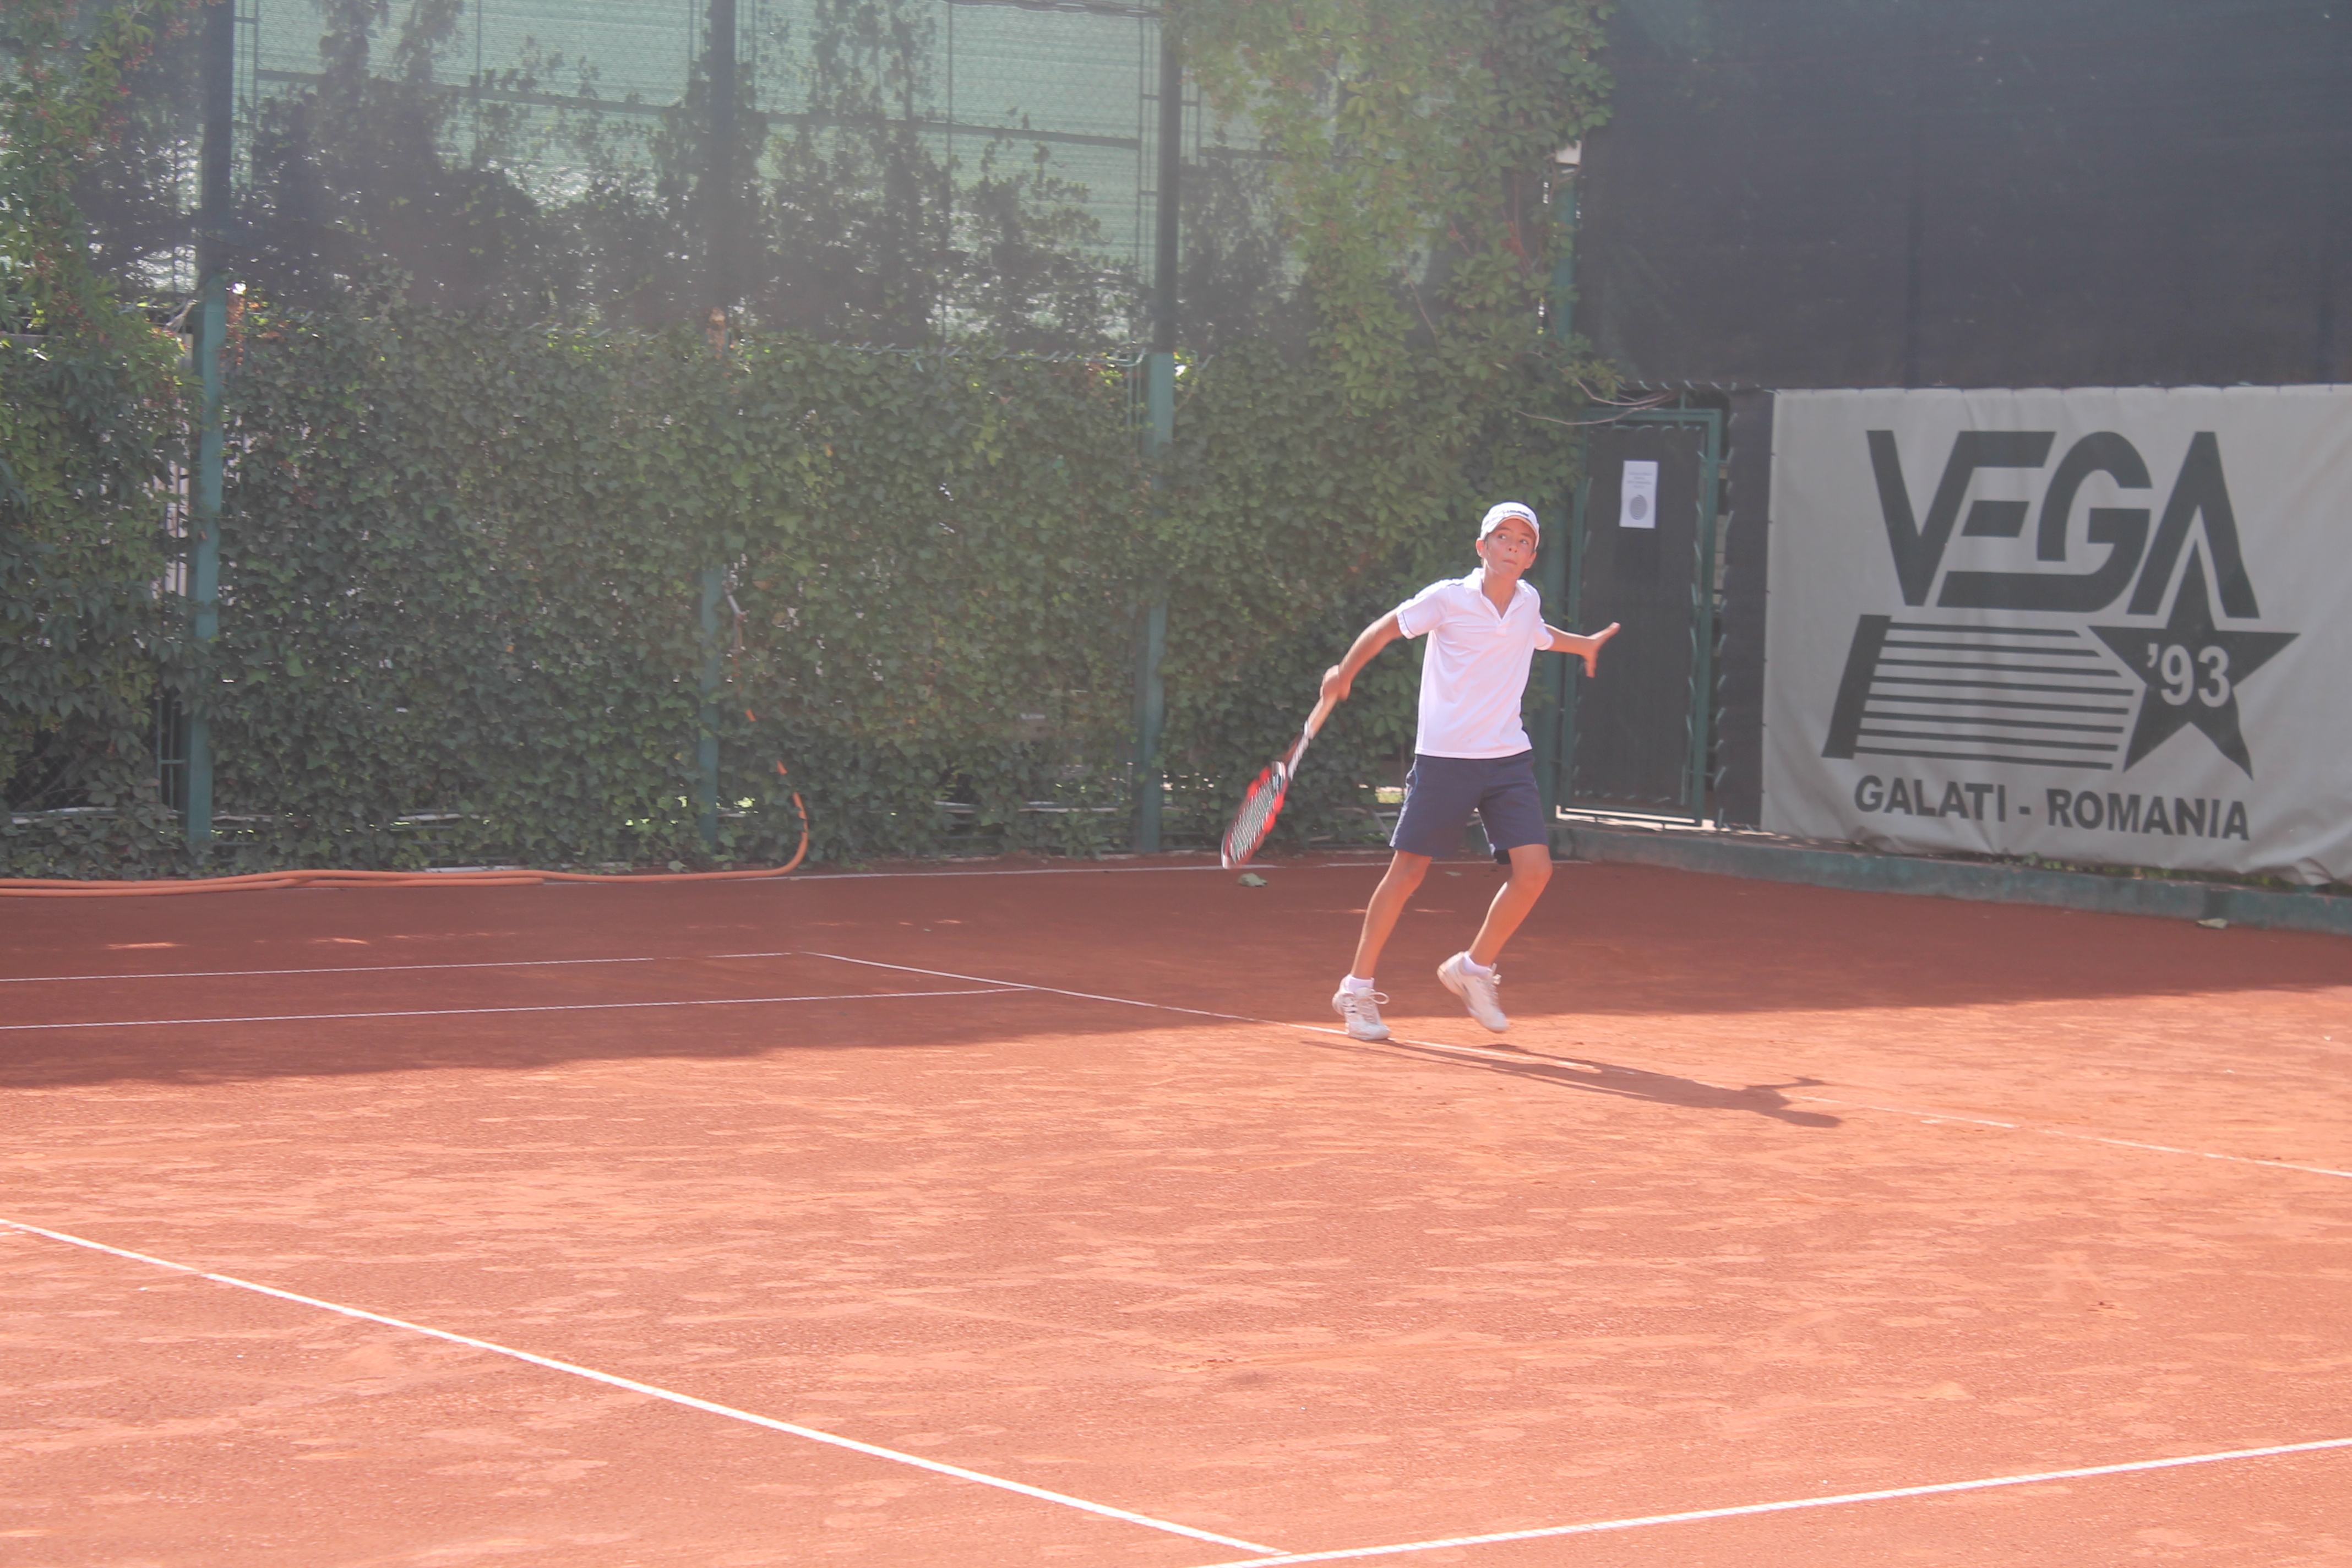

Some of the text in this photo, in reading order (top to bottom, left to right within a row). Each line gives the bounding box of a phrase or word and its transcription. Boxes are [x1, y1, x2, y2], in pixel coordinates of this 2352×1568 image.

[1866, 430, 2261, 619] VEGA
[1854, 774, 2006, 823] GALATI
[2046, 788, 2251, 842] ROMANIA
